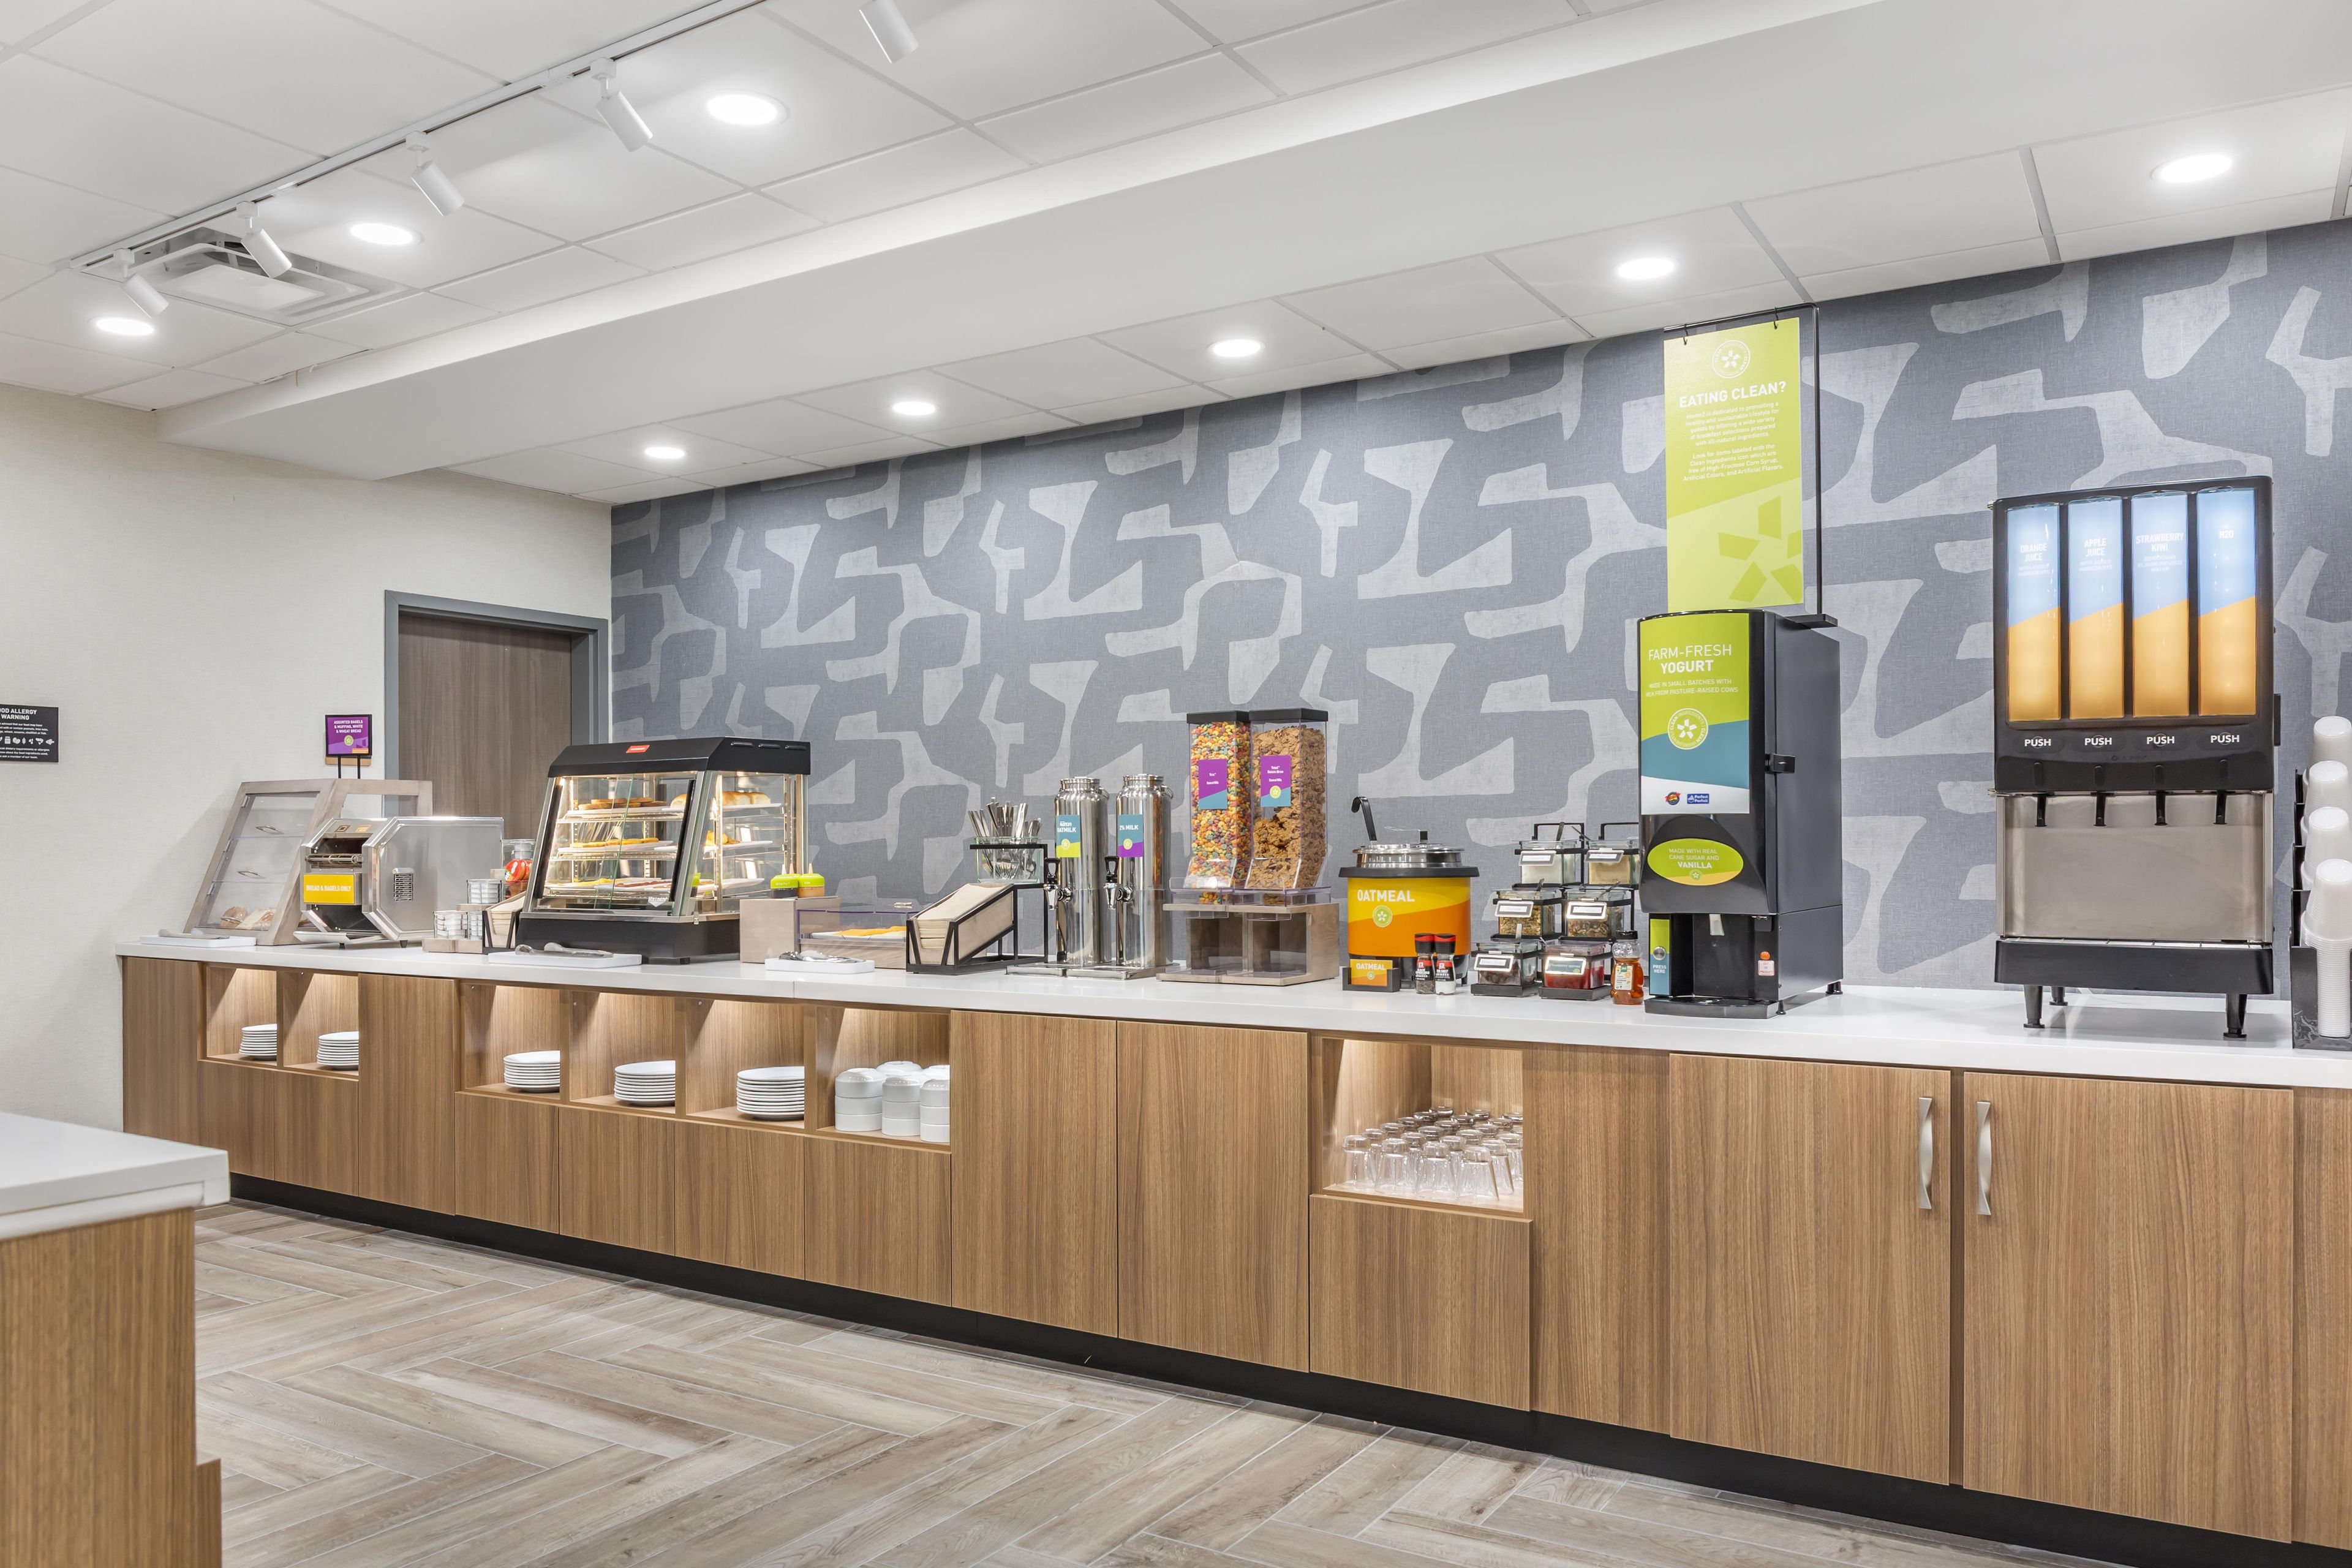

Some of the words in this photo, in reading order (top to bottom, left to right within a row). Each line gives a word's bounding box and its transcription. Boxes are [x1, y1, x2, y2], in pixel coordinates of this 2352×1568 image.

[1679, 390, 1728, 409] EATING
[1732, 381, 1787, 399] CLEAN?
[1713, 407, 1738, 415] dedicated
[1746, 402, 1774, 411] promoting
[1717, 413, 1748, 422] sustainable
[1716, 421, 1737, 429] offering
[1751, 423, 1776, 432] prepared
[1708, 436, 1736, 445] all-natural
[1737, 431, 1770, 441] ingredients.
[1706, 462, 1745, 471] High-Fructose
[2084, 538, 2107, 548] APPLE
[2135, 533, 2184, 544] STRAWBERRY
[2020, 543, 2048, 553] ORANGE
[2086, 548, 2106, 557] JUICE
[2151, 543, 2168, 552] KIWI
[2024, 552, 2043, 562] JUICE
[1648, 644, 1732, 661] FARM-FRESH
[1660, 660, 1714, 674] YOGURT
[1670, 715, 1678, 730] CLEAN
[1696, 728, 1706, 743] CLEAN
[2146, 736, 2175, 745] PUSH
[2211, 734, 2240, 744] PUSH
[2024, 738, 2052, 747] PUSH
[2084, 737, 2113, 746] PUSH
[1357, 889, 1415, 902] OATMEAL
